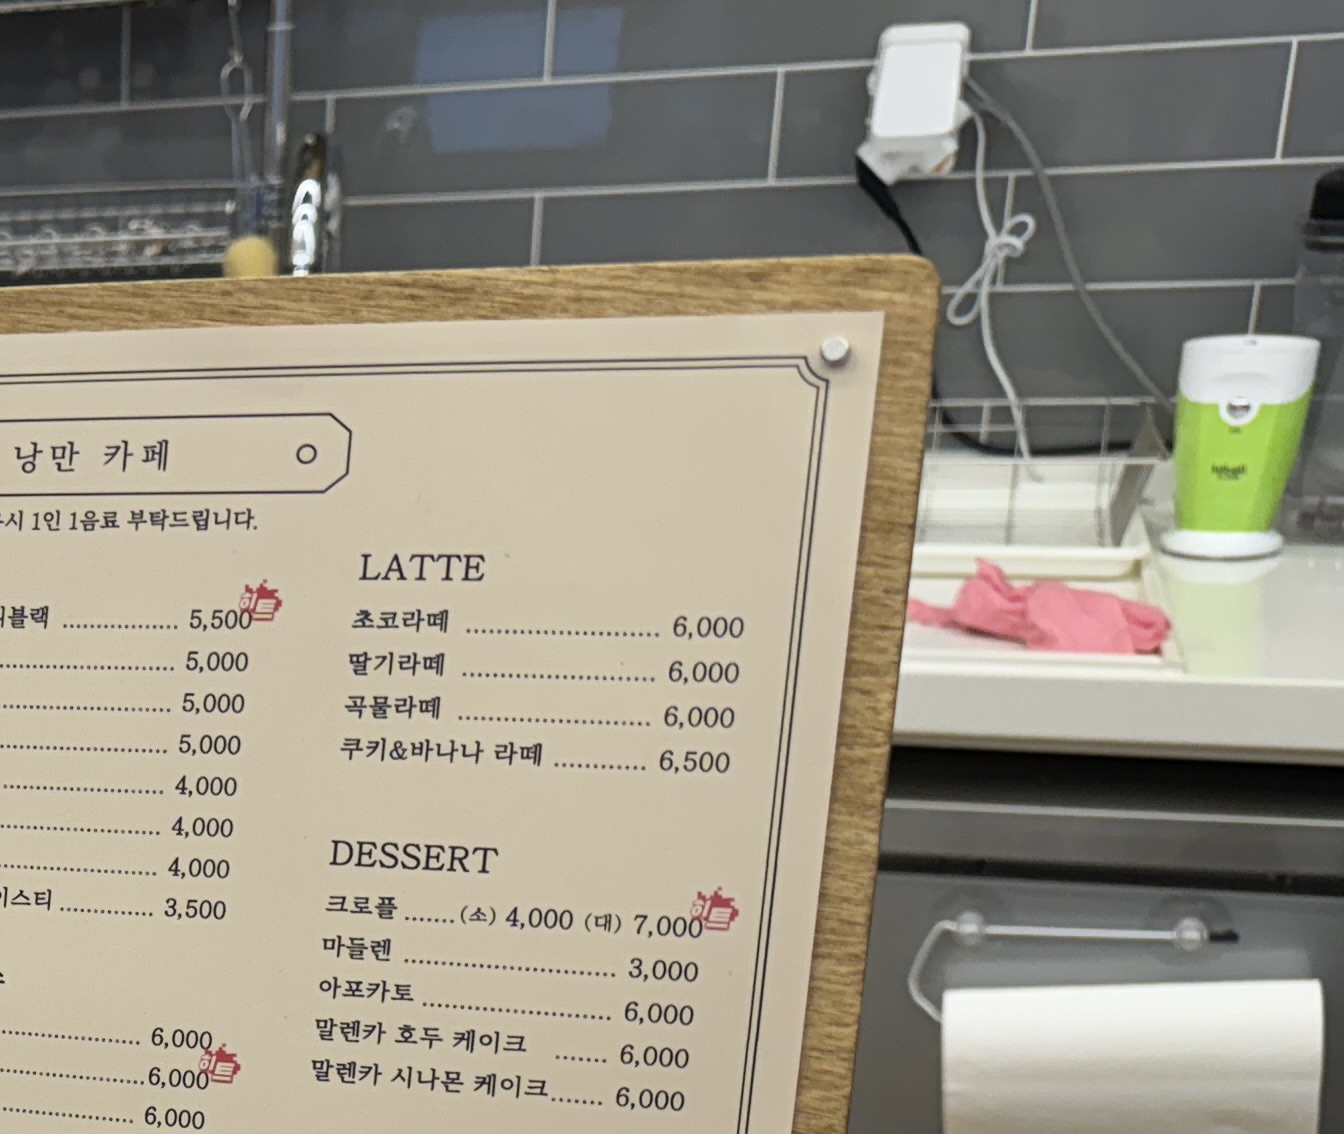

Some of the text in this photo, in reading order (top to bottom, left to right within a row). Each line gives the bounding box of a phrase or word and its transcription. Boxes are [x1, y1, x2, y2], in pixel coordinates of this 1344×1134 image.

[13, 438, 169, 474] 낭만 카페
[31, 509, 61, 532] 1인
[68, 510, 121, 532] 1음료
[127, 507, 258, 532] 부탁드립니다.
[358, 553, 486, 582] LATTE
[189, 609, 253, 630] 5,500
[351, 608, 745, 640] 초코라떼 6,000
[185, 650, 249, 674] 5,000
[348, 651, 740, 685] 딸기라떼 6,000
[182, 692, 245, 715] 5,000
[344, 695, 735, 730] 곡물라떼 6,000
[178, 734, 242, 757] 5,000
[340, 737, 731, 774] 쿠키&바나나 라떼 6,500
[174, 774, 238, 798] 4,000
[171, 815, 234, 839] 4,000
[167, 856, 231, 880] 4,000
[328, 839, 499, 874] DESSERT
[164, 897, 227, 921] 3,500
[325, 895, 702, 939] 크로플 (소) 4,000 (대) 7,000
[322, 934, 699, 983] 마들렌 3,000
[319, 976, 695, 1026] 아포카토 6,000
[151, 1028, 212, 1050] 6,000
[314, 1017, 690, 1069] 말렌카 호두 케이크 6,000
[148, 1068, 209, 1090] 6,000
[311, 1058, 685, 1112] 말렌카 시나몬 케이크 6,000
[144, 1105, 205, 1130] 6,000
